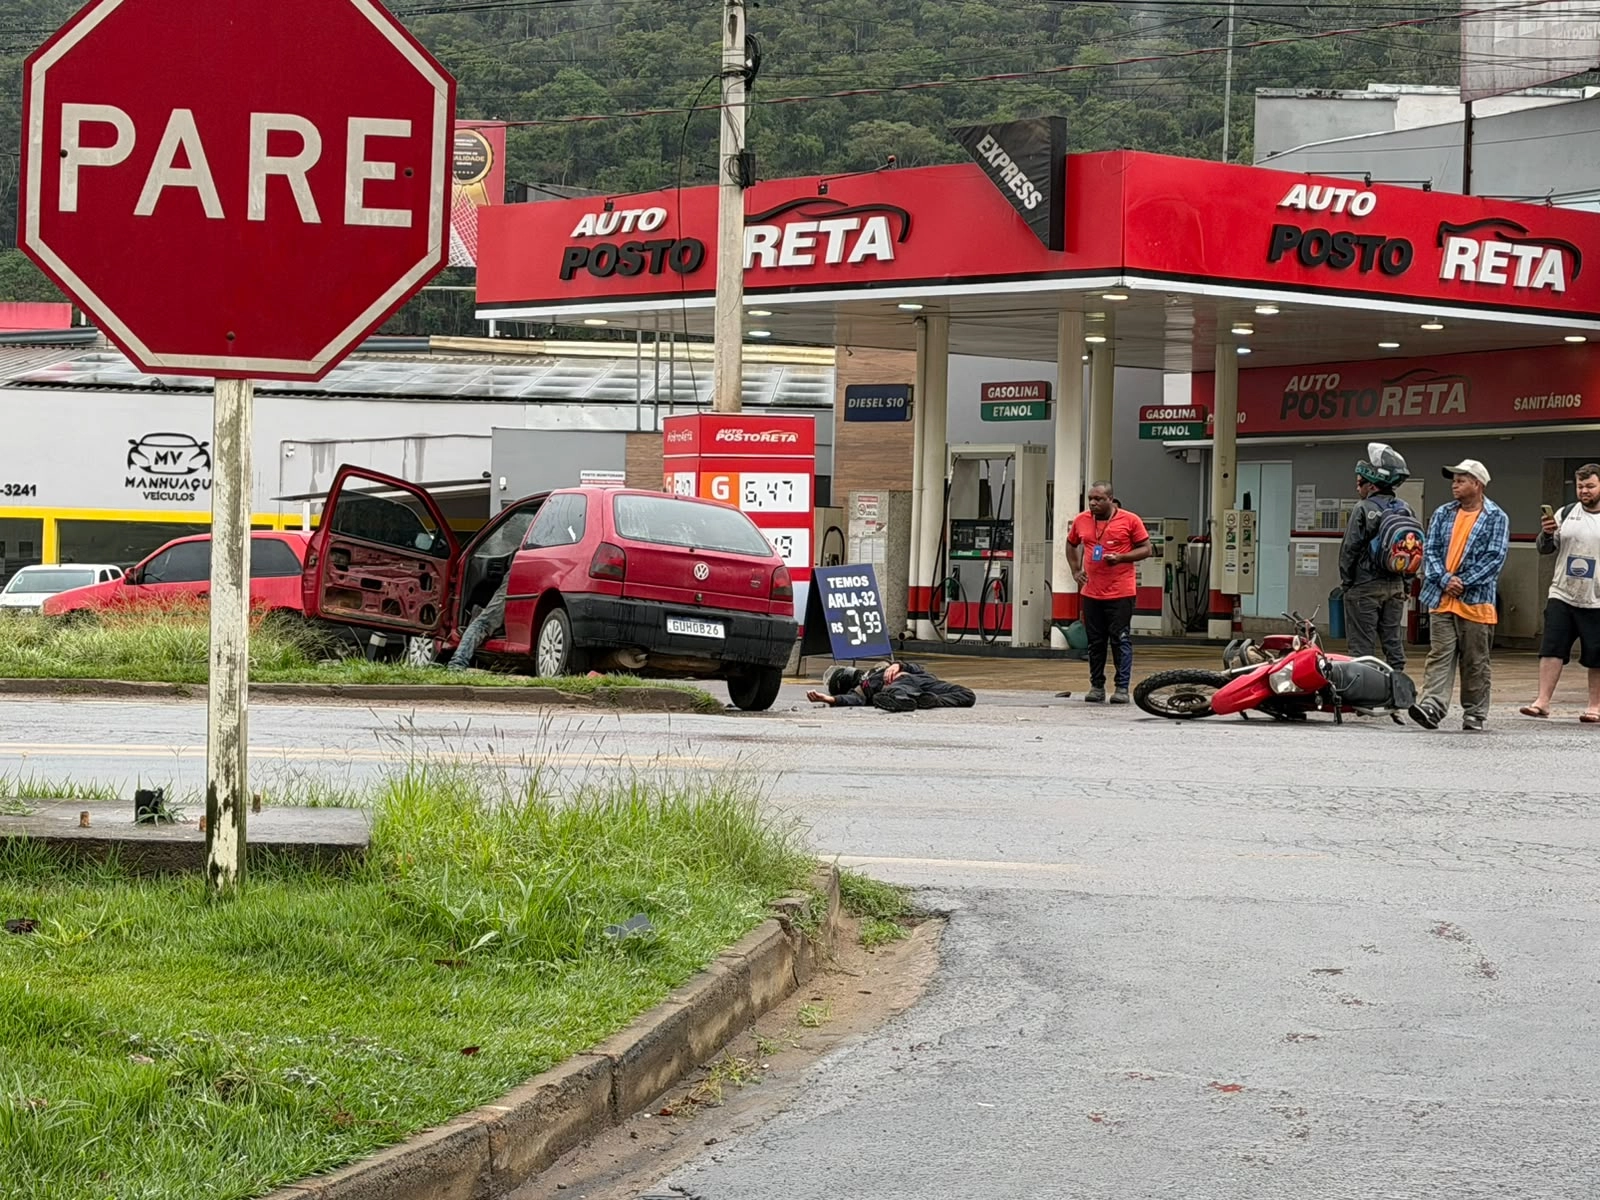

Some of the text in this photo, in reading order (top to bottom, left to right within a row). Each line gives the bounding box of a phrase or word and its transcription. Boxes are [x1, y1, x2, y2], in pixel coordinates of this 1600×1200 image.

[58, 103, 413, 228] PARE
[976, 134, 1043, 209] EXPRESS
[1277, 184, 1377, 217] AUTO
[569, 207, 667, 238] AUTO
[559, 215, 895, 280] POSTO RETA
[1266, 223, 1567, 292] POSTO RETA
[987, 384, 1039, 398] GASOLINA
[1284, 373, 1341, 392] AUTO
[848, 397, 905, 408] DIESEL S10
[1279, 382, 1467, 420] POSTO RETA
[1513, 391, 1582, 411] SANITÁRIOS
[992, 405, 1033, 417] ETANOL
[1145, 408, 1197, 420] GASOLINA
[1151, 426, 1191, 436] ETANOL
[154, 451, 183, 465] MV
[125, 476, 212, 491] MANHUAÇU
[711, 476, 730, 500] G
[745, 481, 793, 507] 6,47
[143, 490, 195, 501] VEÍCULOS
[827, 575, 869, 588] TEMOS
[828, 591, 877, 608] ARLA-32
[831, 609, 882, 645] R$ 3,99
